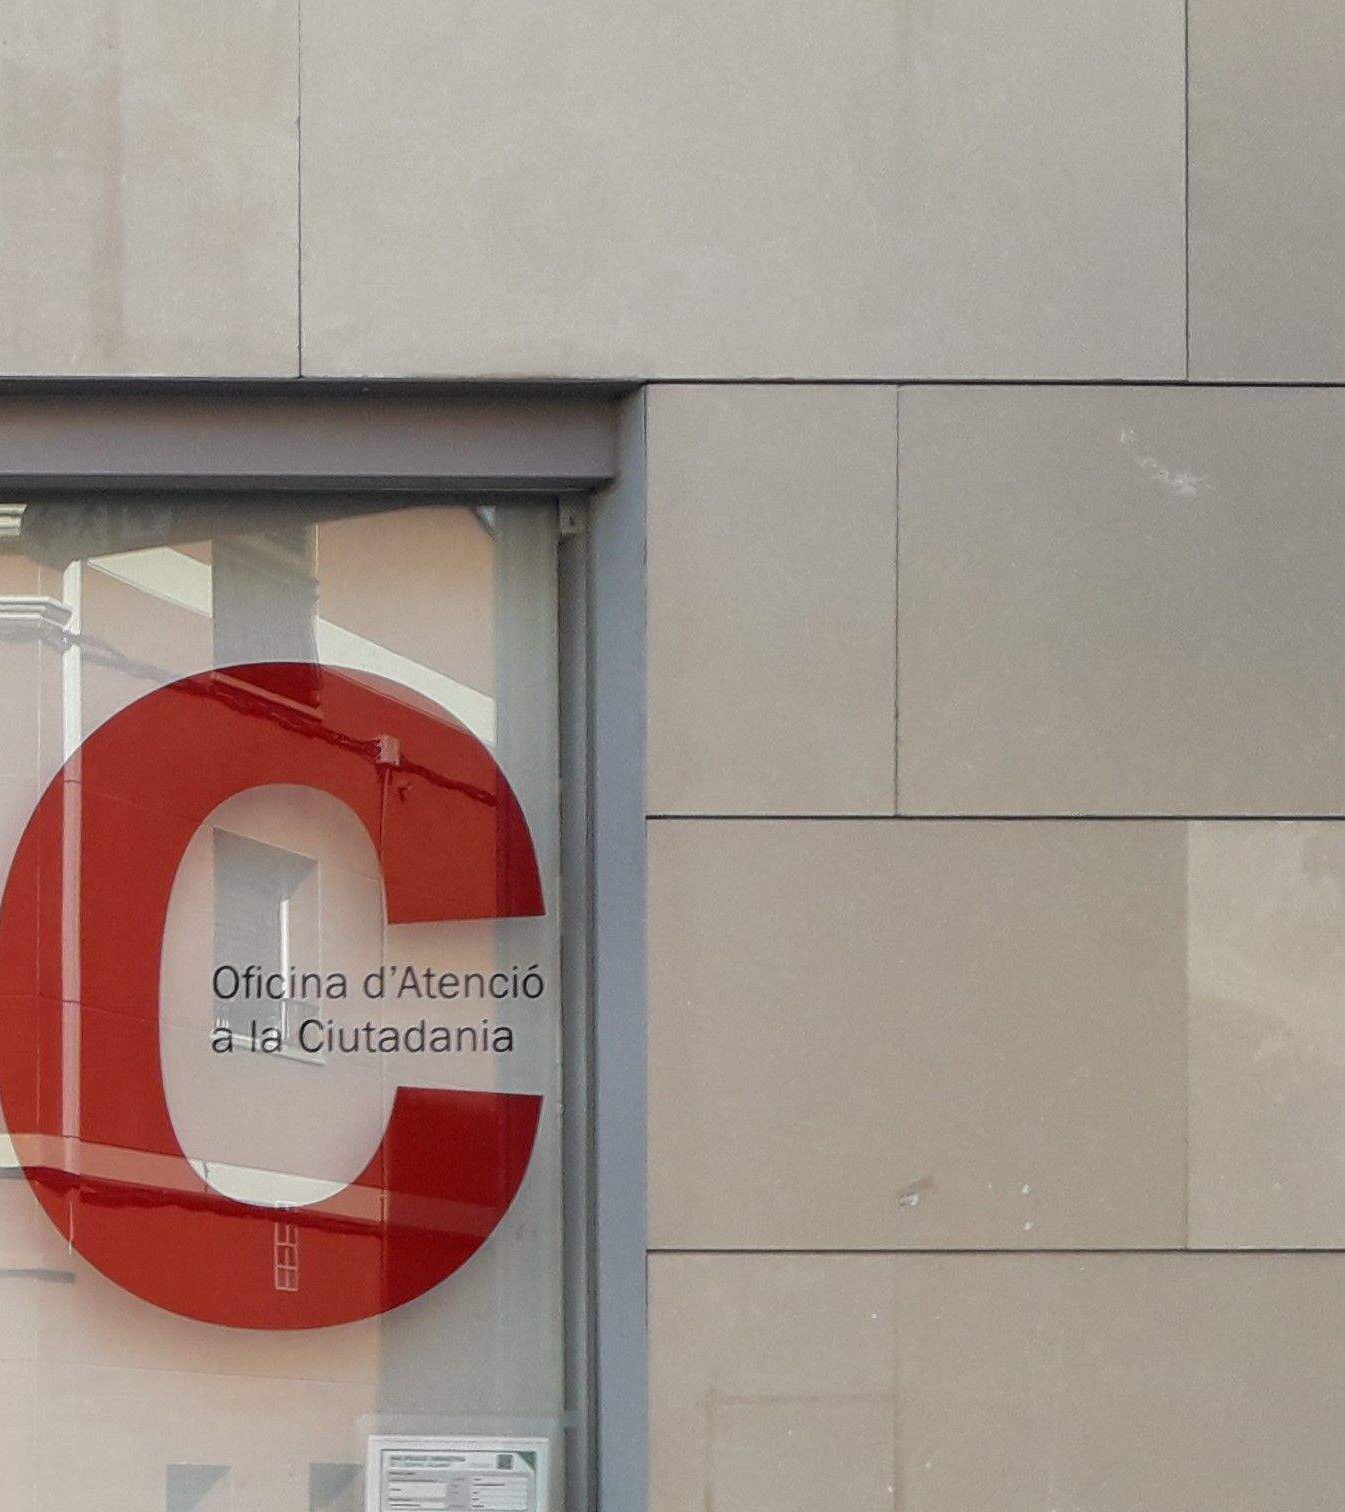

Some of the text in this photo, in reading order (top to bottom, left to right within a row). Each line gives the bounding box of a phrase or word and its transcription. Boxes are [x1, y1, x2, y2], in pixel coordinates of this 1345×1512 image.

[212, 964, 545, 1000] Oficina d'Atenció
[212, 1018, 514, 1054] a la Ciutadania
